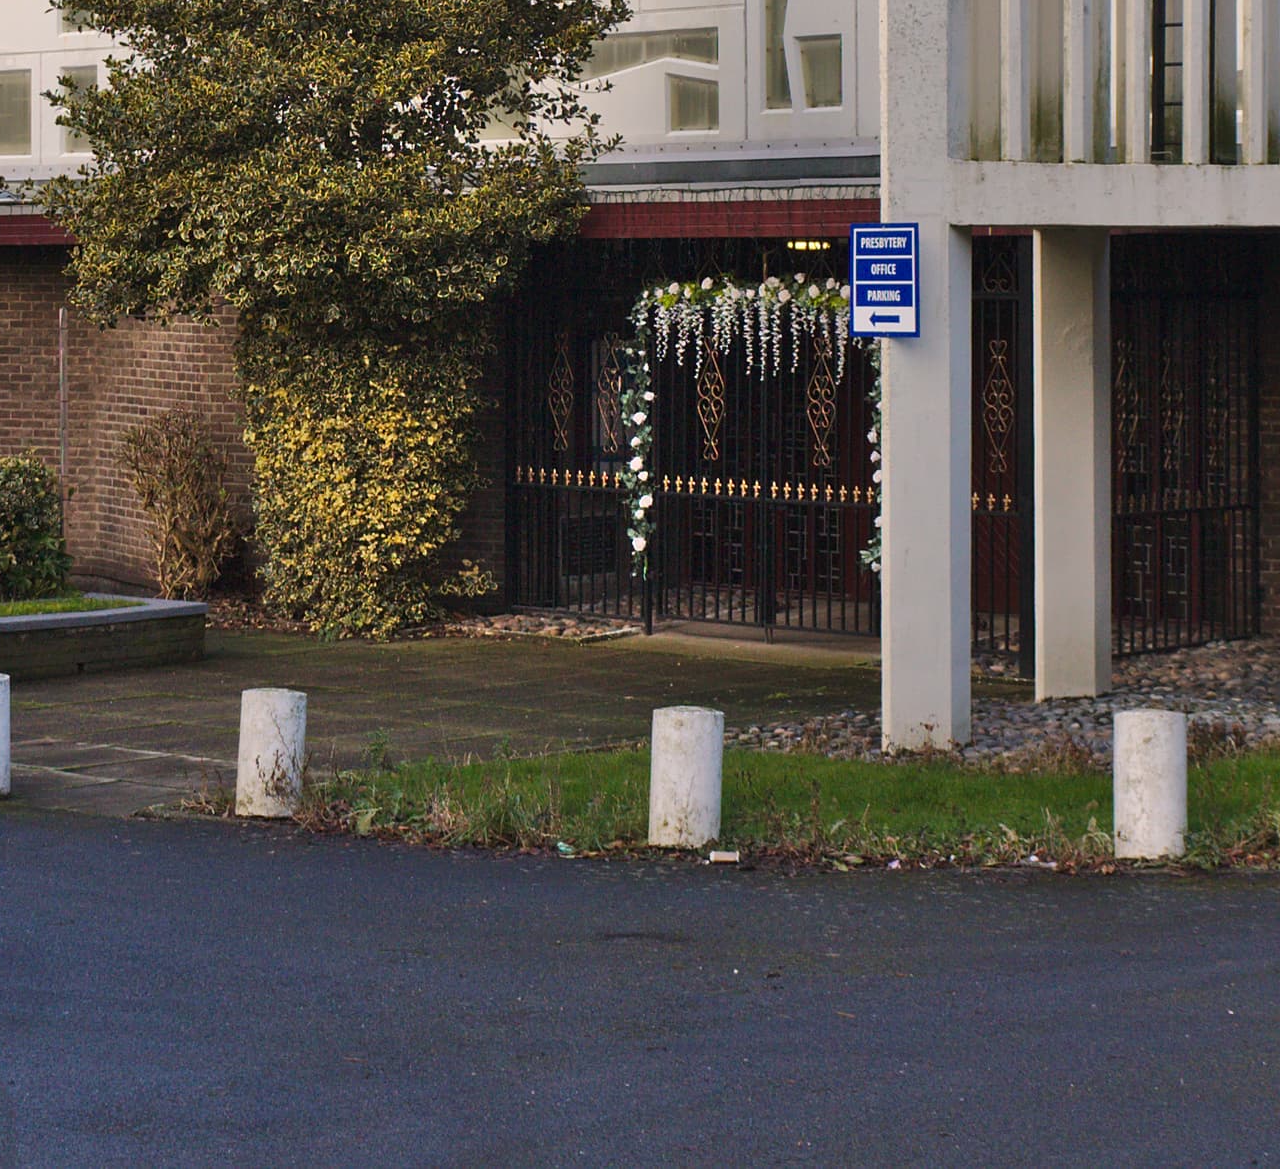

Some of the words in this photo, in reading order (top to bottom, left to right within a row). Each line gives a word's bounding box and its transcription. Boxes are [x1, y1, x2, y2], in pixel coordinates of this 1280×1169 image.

[861, 237, 907, 248] PRESBYTERY
[871, 263, 896, 275] OFFICE
[867, 290, 900, 301] PARKING
